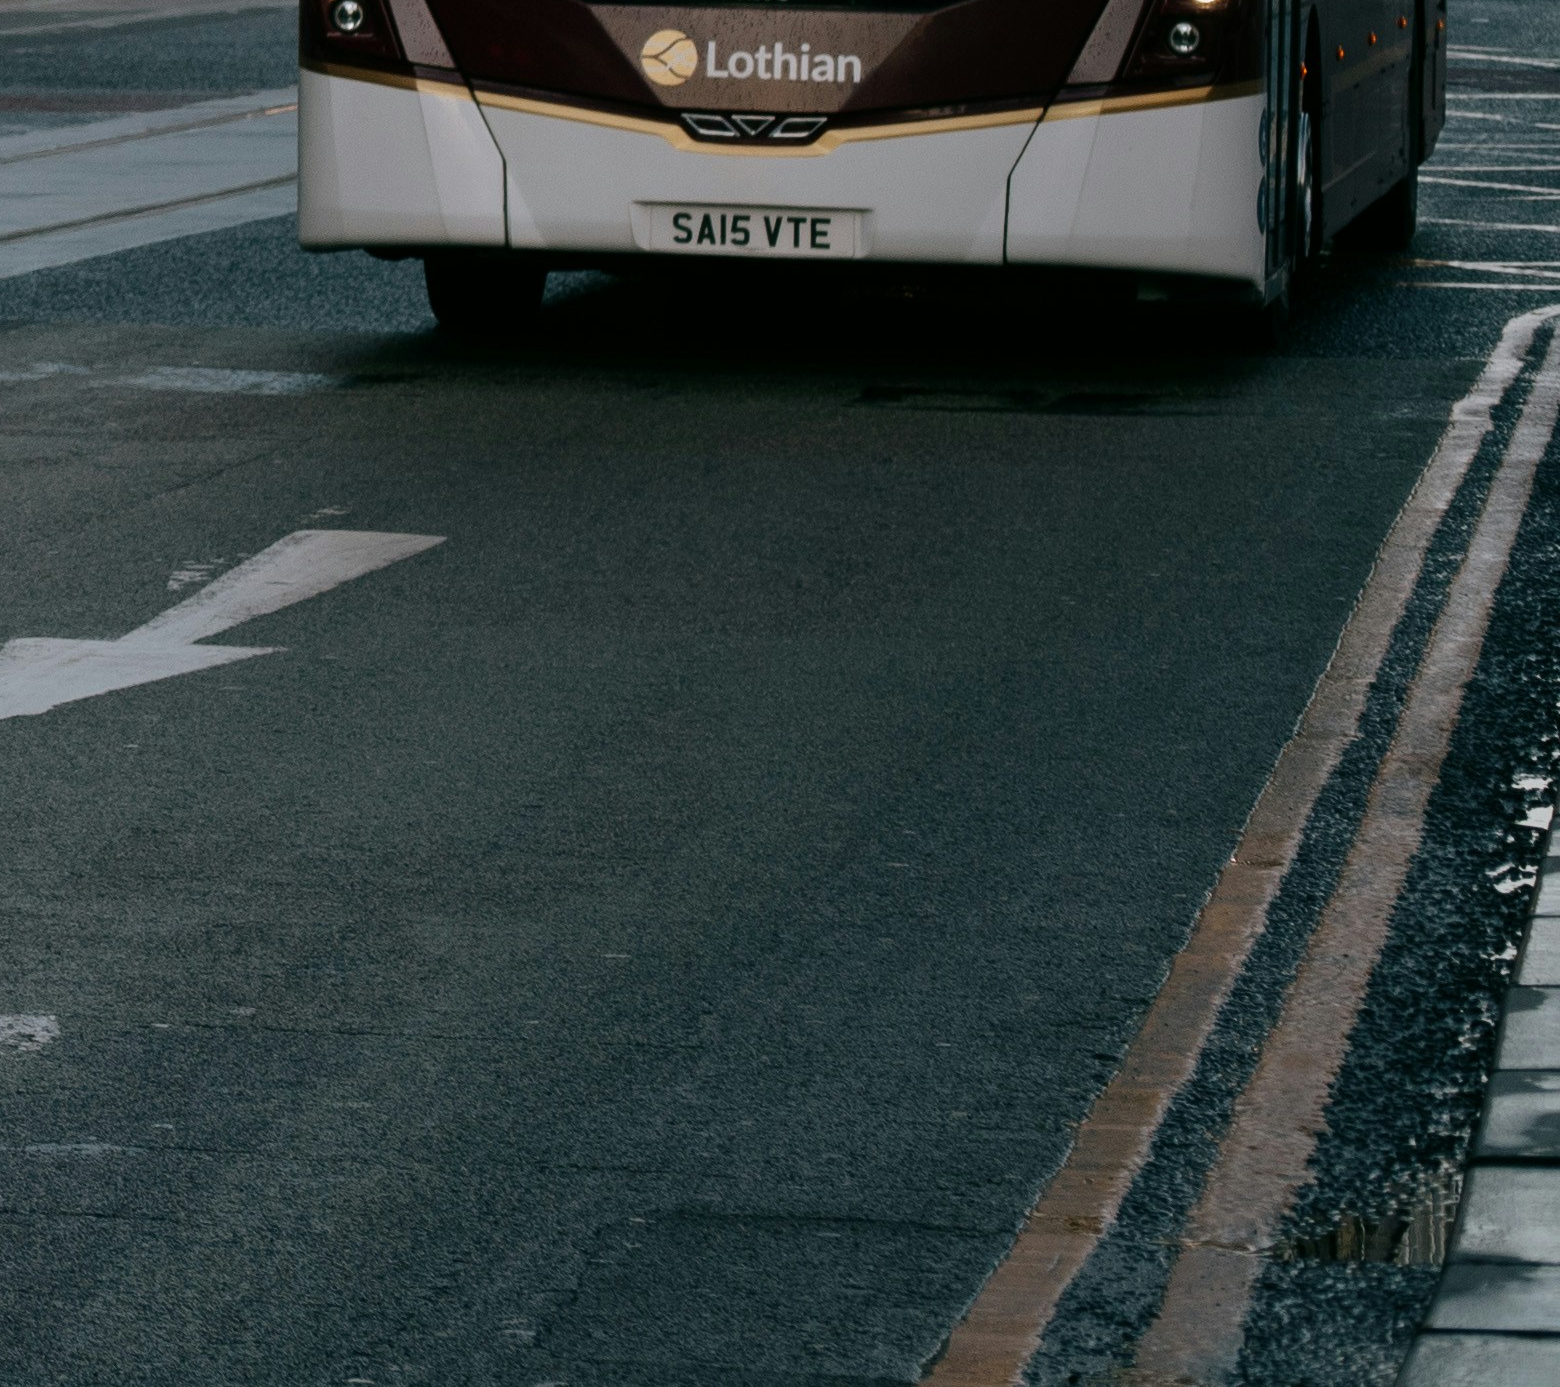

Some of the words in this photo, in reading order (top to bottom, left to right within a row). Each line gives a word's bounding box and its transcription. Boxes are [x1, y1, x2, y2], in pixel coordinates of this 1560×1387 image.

[705, 41, 862, 84] Lothian
[672, 212, 751, 246] SA15
[763, 215, 832, 250] VTE
